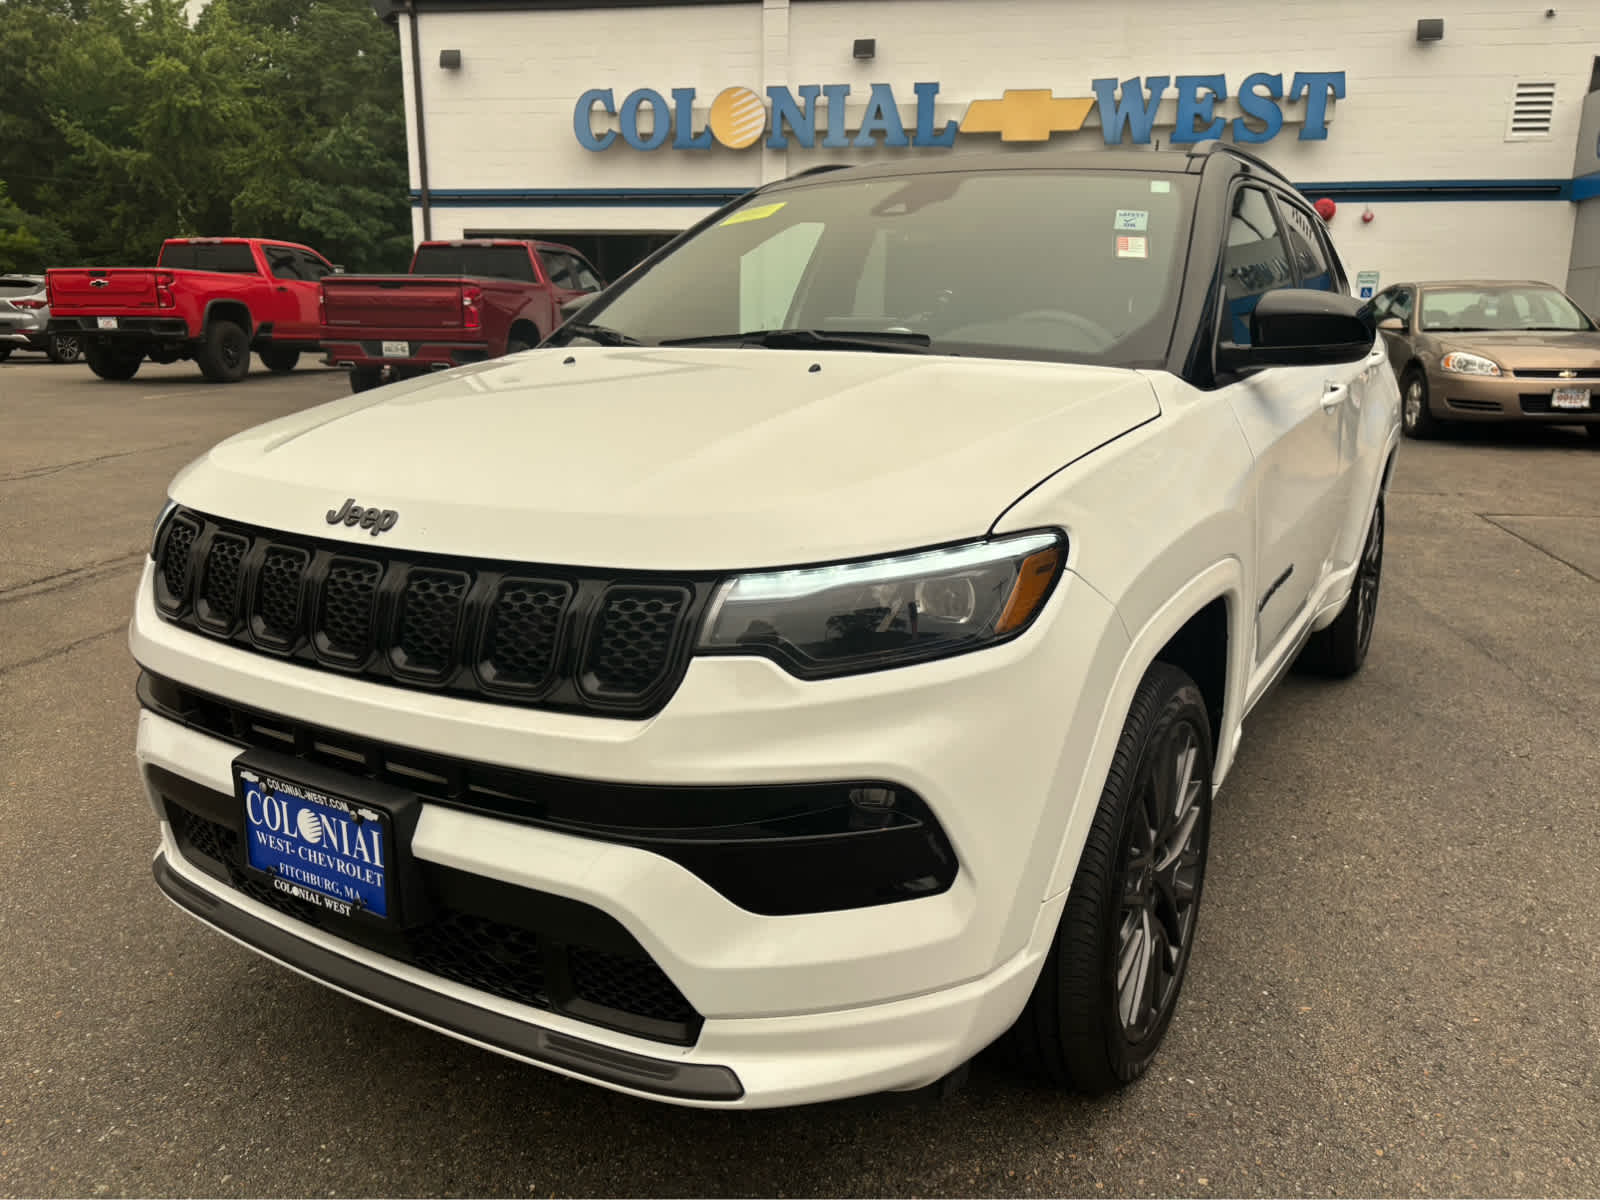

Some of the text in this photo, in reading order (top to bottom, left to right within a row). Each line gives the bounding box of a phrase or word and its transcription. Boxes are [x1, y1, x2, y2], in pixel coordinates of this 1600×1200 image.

[573, 71, 1346, 152] COLONIAL WEST
[325, 498, 399, 536] Jeep
[246, 790, 384, 868] COLONIAL
[279, 862, 361, 902] FITCHBURG, MA
[298, 846, 383, 887] CHEVROLET
[274, 879, 351, 916] COLONIAL WEST
